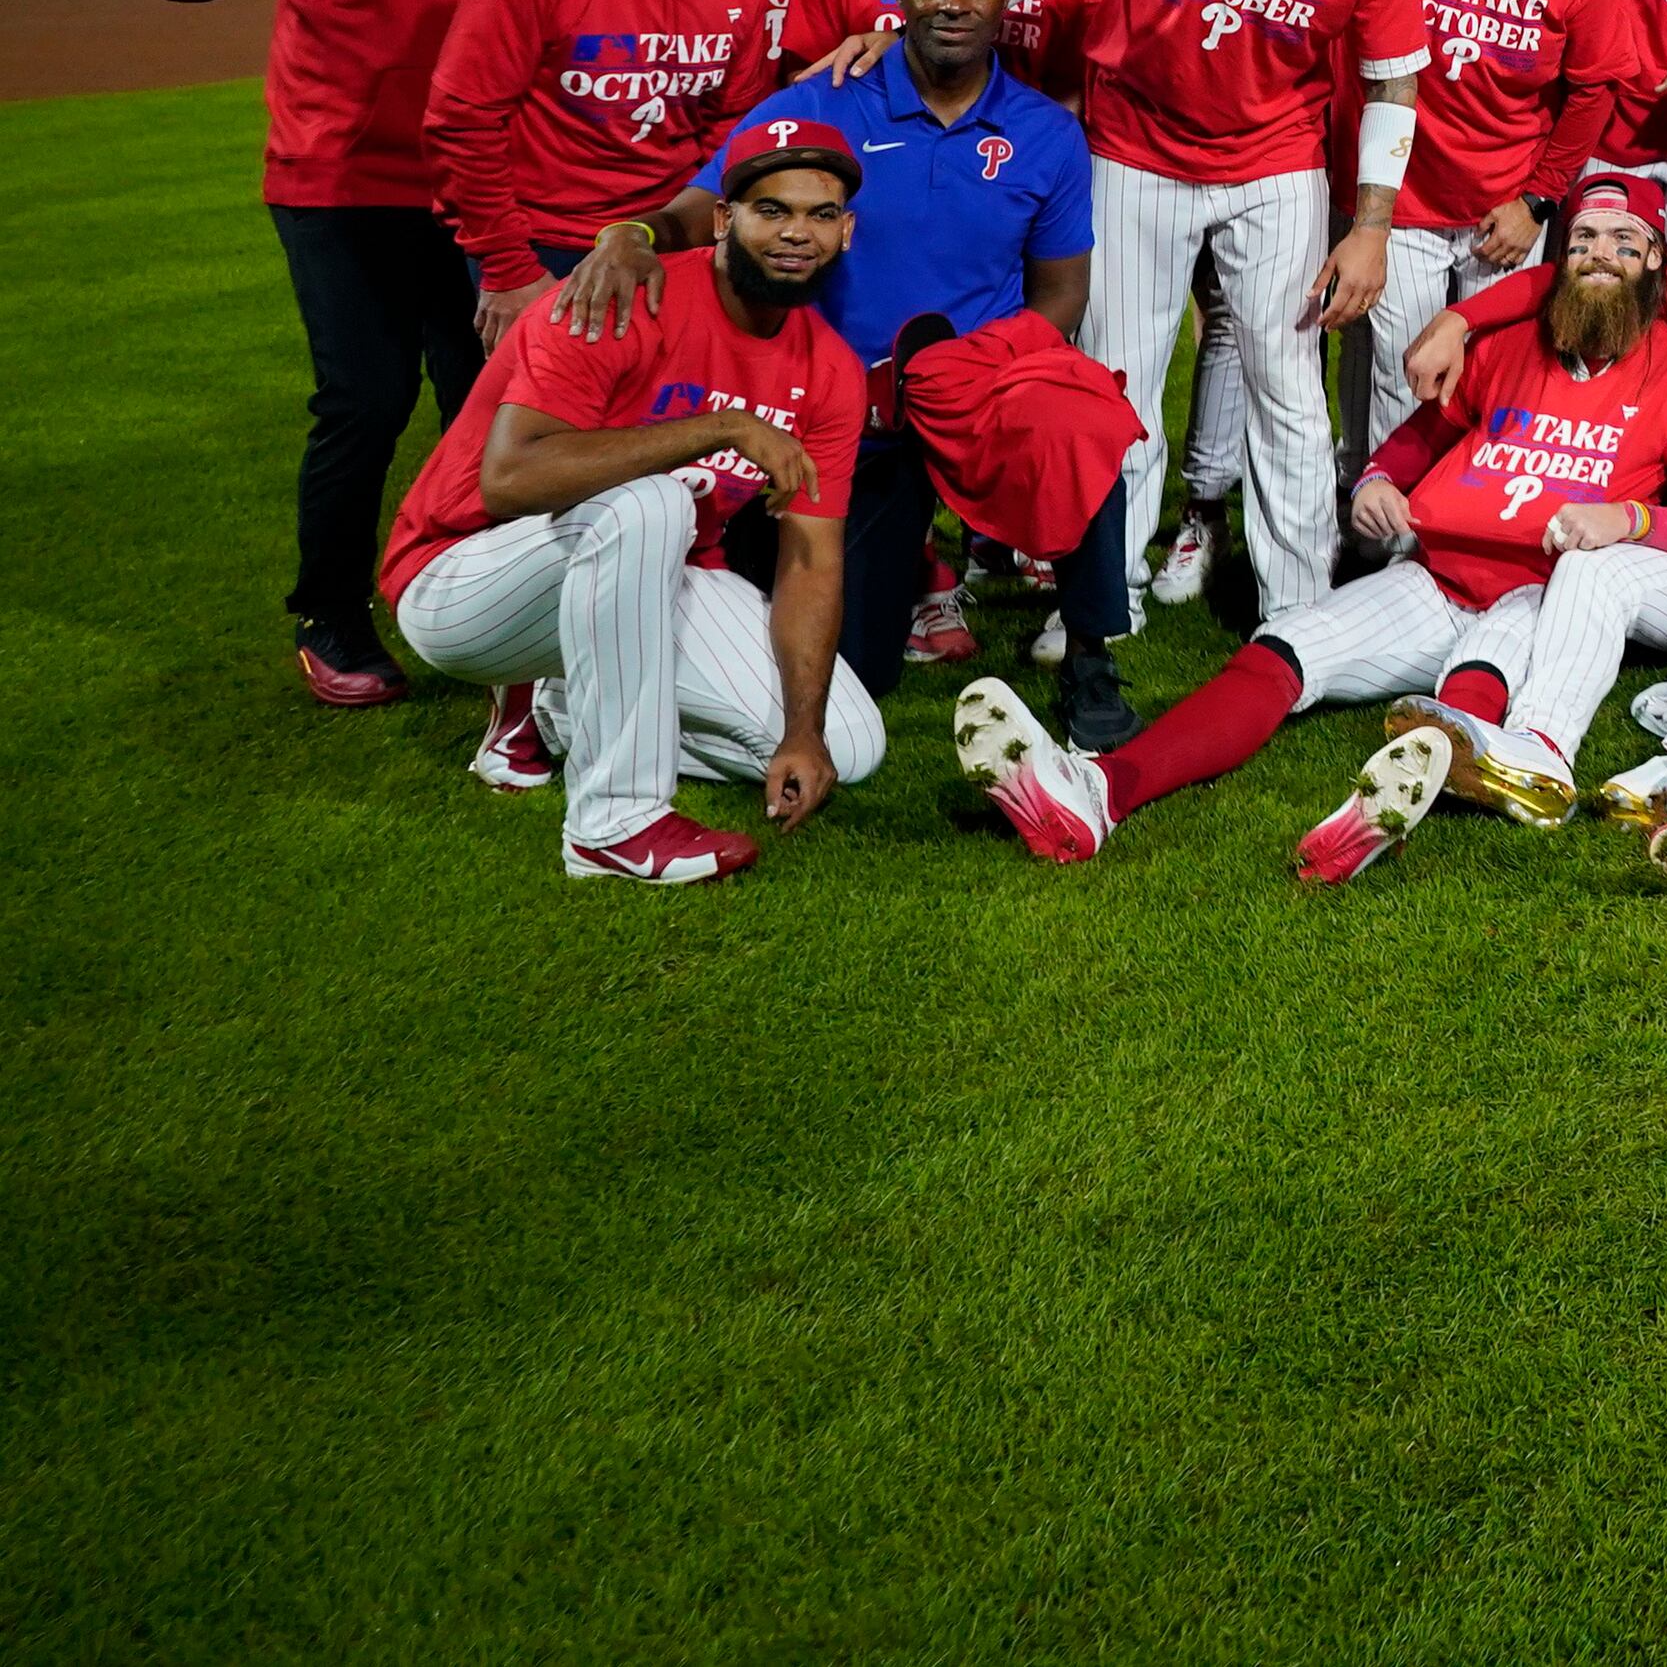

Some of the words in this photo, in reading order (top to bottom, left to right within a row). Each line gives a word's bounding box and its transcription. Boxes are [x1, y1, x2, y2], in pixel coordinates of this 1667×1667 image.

[1202, 3, 1242, 50] P
[1423, 0, 1541, 50] CTOBER
[640, 34, 732, 63] TAKE
[1443, 38, 1480, 80] P
[977, 137, 1012, 180] P
[1533, 413, 1624, 454] TAKE
[1473, 443, 1613, 487] OCTOBER
[1500, 475, 1543, 520] P
